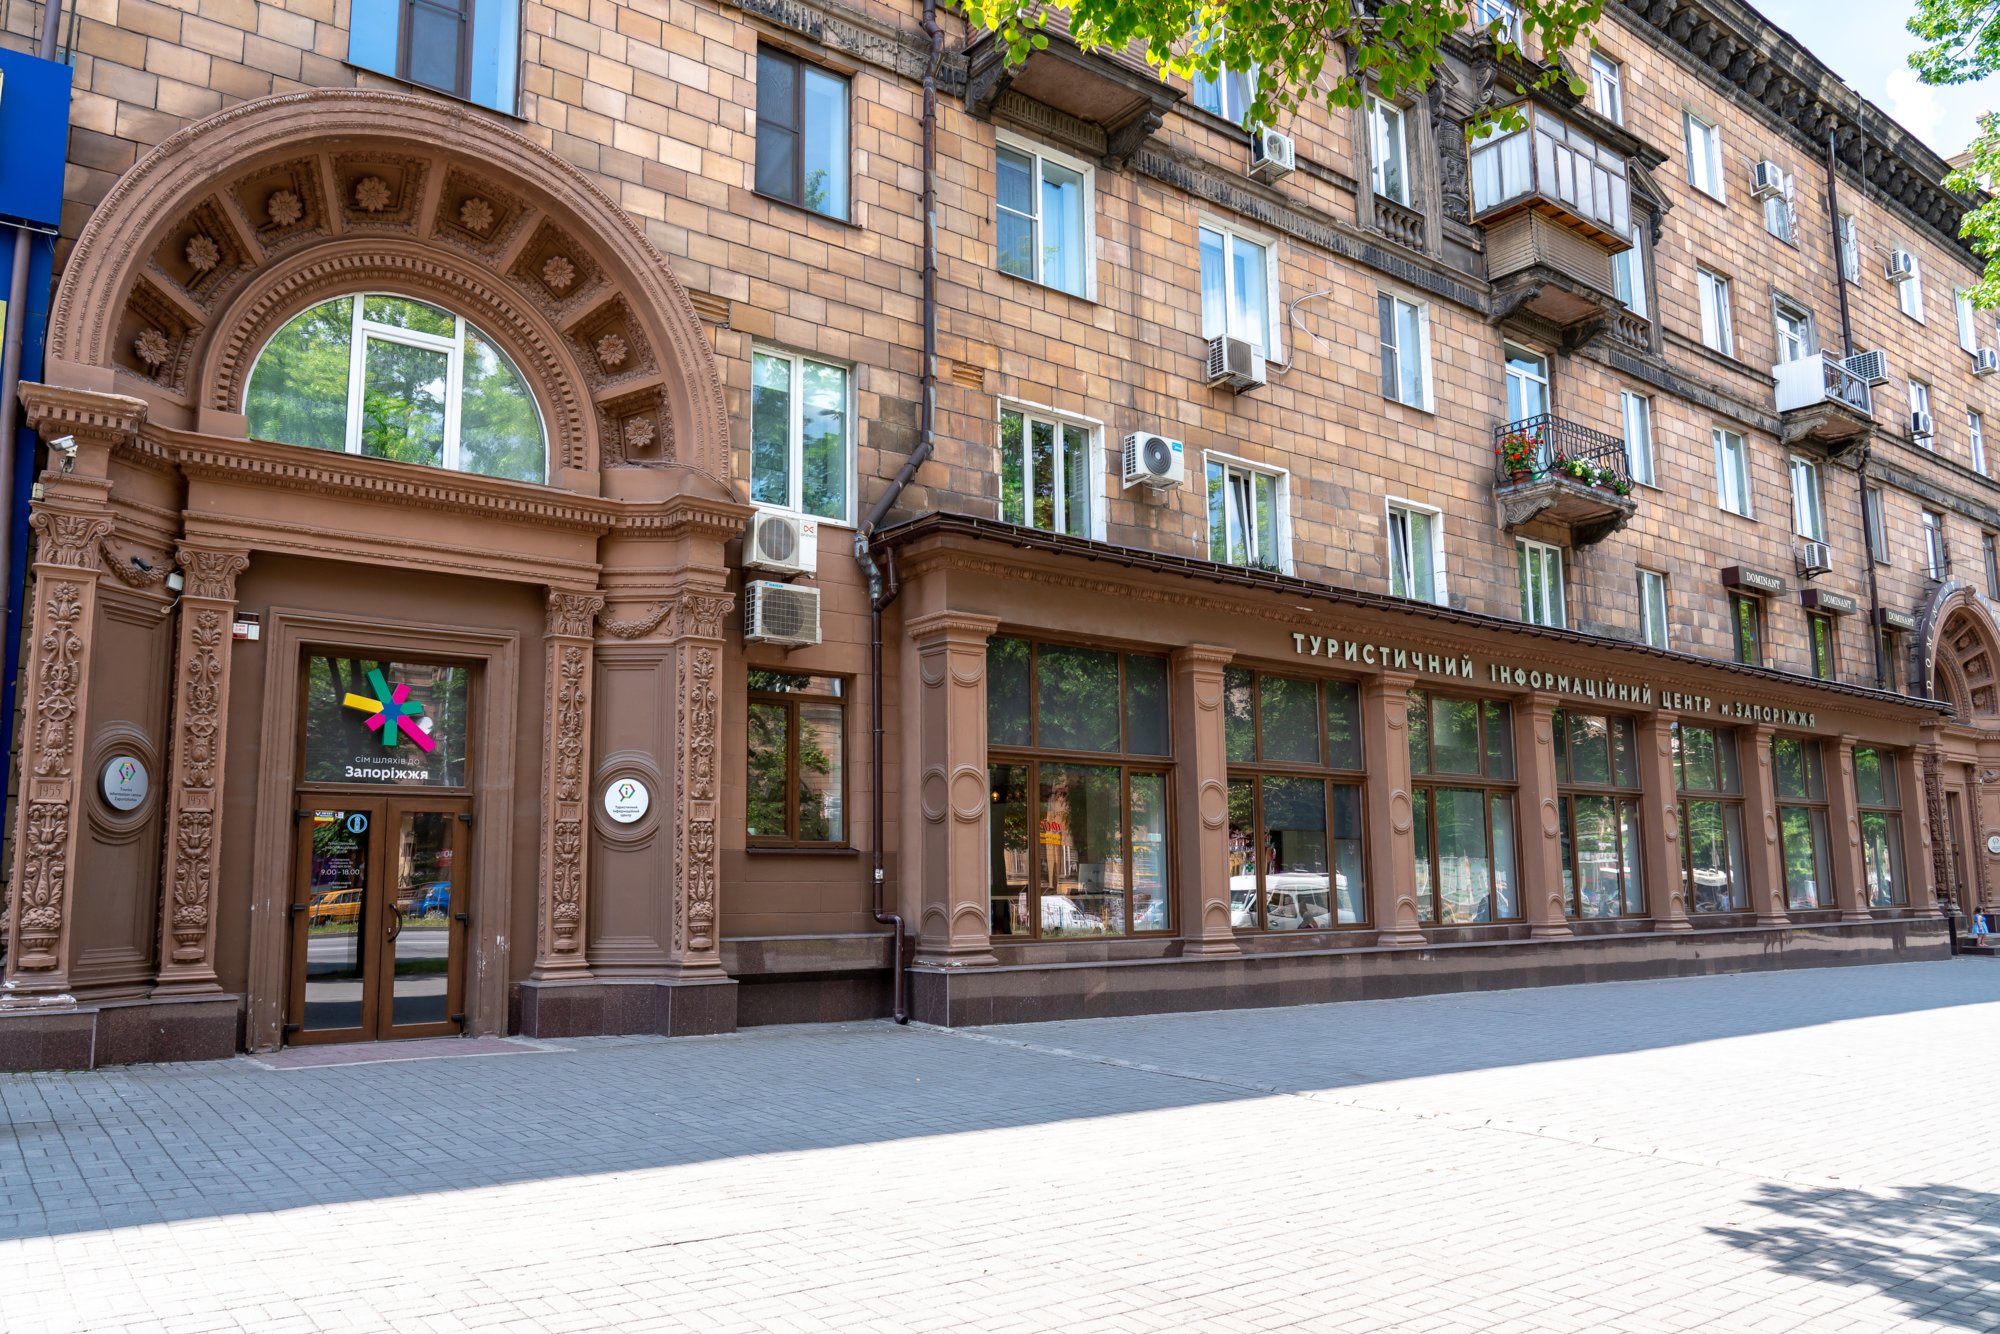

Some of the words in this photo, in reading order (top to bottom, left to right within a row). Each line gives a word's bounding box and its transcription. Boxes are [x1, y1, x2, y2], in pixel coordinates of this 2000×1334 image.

[1745, 571, 1781, 590] DOMINANT
[1822, 593, 1852, 609] DOMINANT
[1888, 611, 1915, 626] DOMINANT
[1926, 581, 1955, 690] DOMINANT
[1293, 632, 1473, 679] ТУРИСТИЧНИЙ
[1491, 663, 1652, 705] ІНФОРМАЦІЙНИЙ
[1662, 691, 1711, 713] ЦЕНТР
[354, 754, 371, 763] сім
[372, 756, 406, 765] шляхів
[407, 757, 420, 766] до
[345, 765, 428, 781] Запоріжжя
[39, 784, 63, 797] 1955
[187, 795, 207, 806] 1955
[561, 807, 576, 816] 1955
